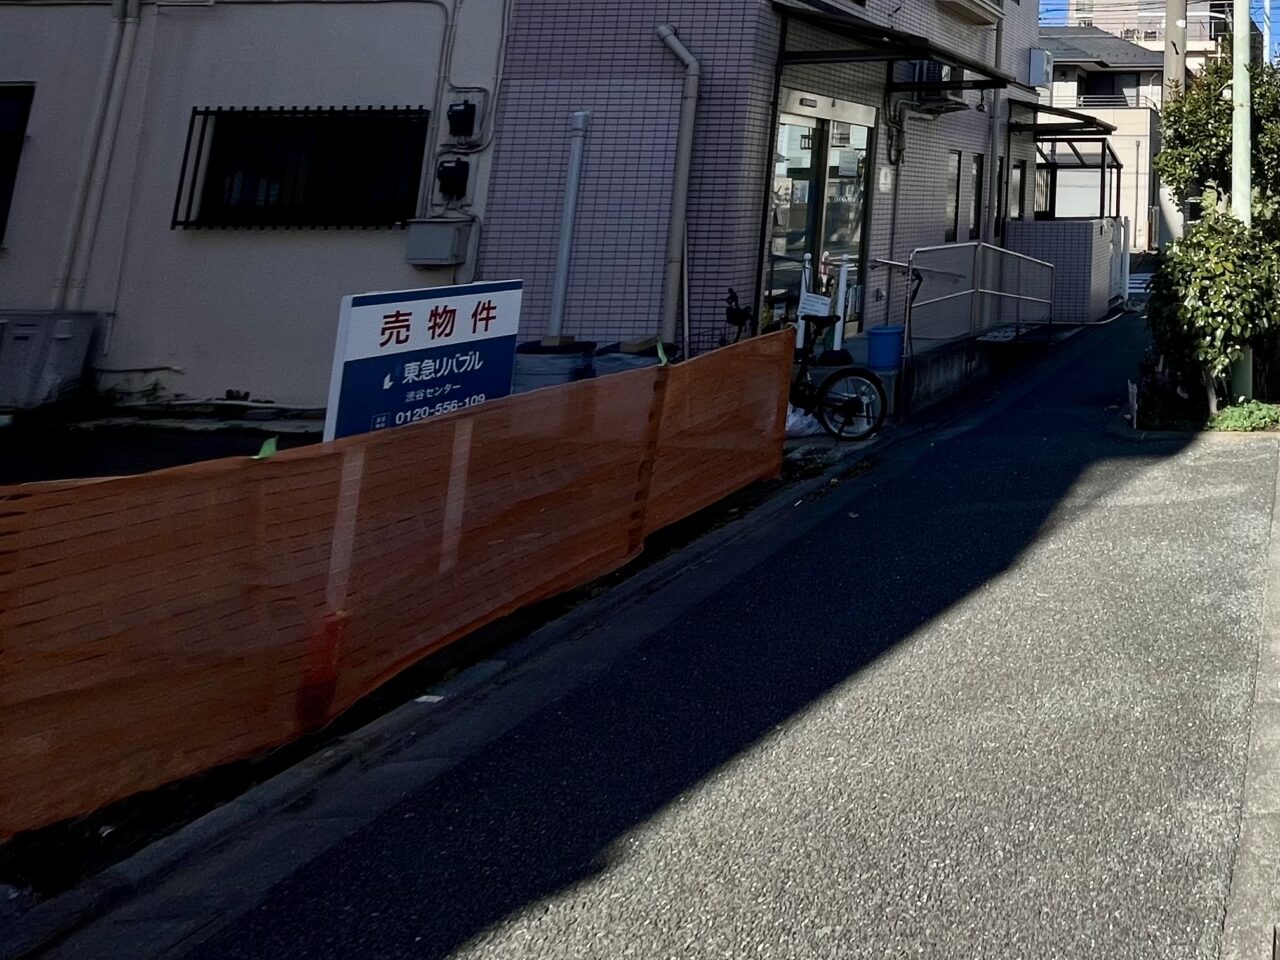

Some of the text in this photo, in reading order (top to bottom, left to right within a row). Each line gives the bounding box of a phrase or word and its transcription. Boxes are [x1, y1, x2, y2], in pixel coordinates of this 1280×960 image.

[379, 299, 498, 349] 売物件
[402, 351, 484, 384] 東急リバブル
[395, 393, 486, 425] 0120-556-109
